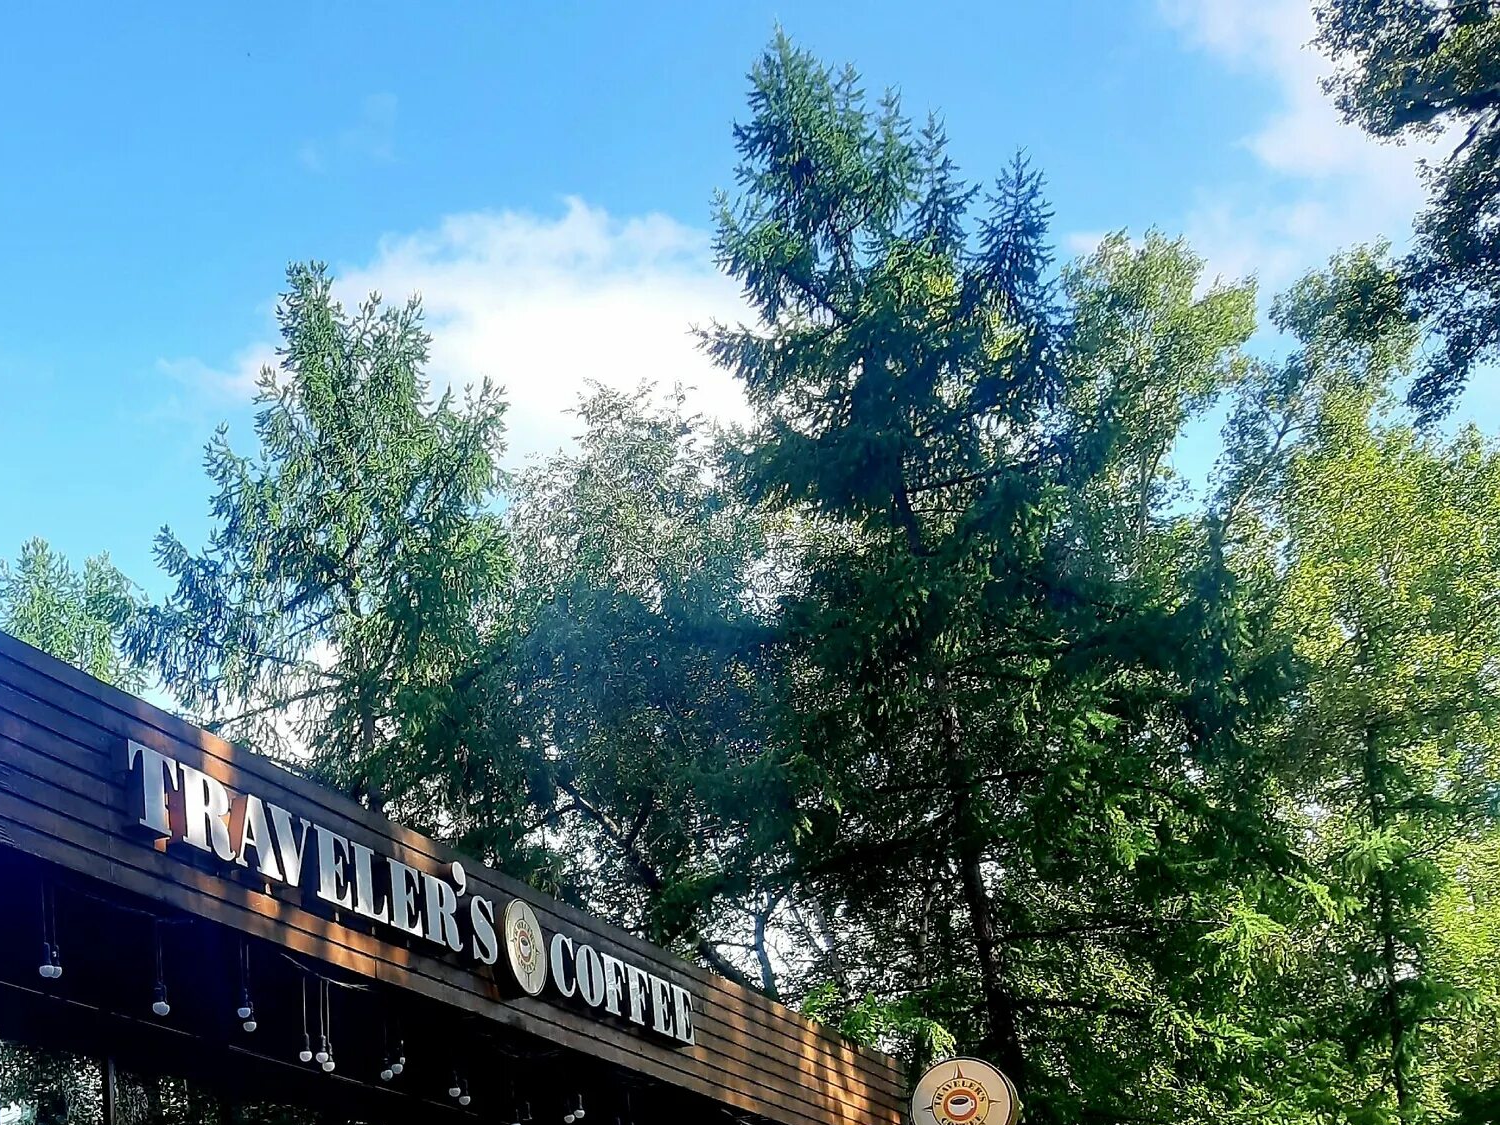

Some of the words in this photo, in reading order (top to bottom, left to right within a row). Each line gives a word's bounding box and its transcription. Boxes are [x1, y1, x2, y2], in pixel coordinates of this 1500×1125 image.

[126, 739, 499, 965] TRAVELER'S
[549, 931, 696, 1046] COFFEE
[934, 1080, 986, 1107] TRAVELER'S
